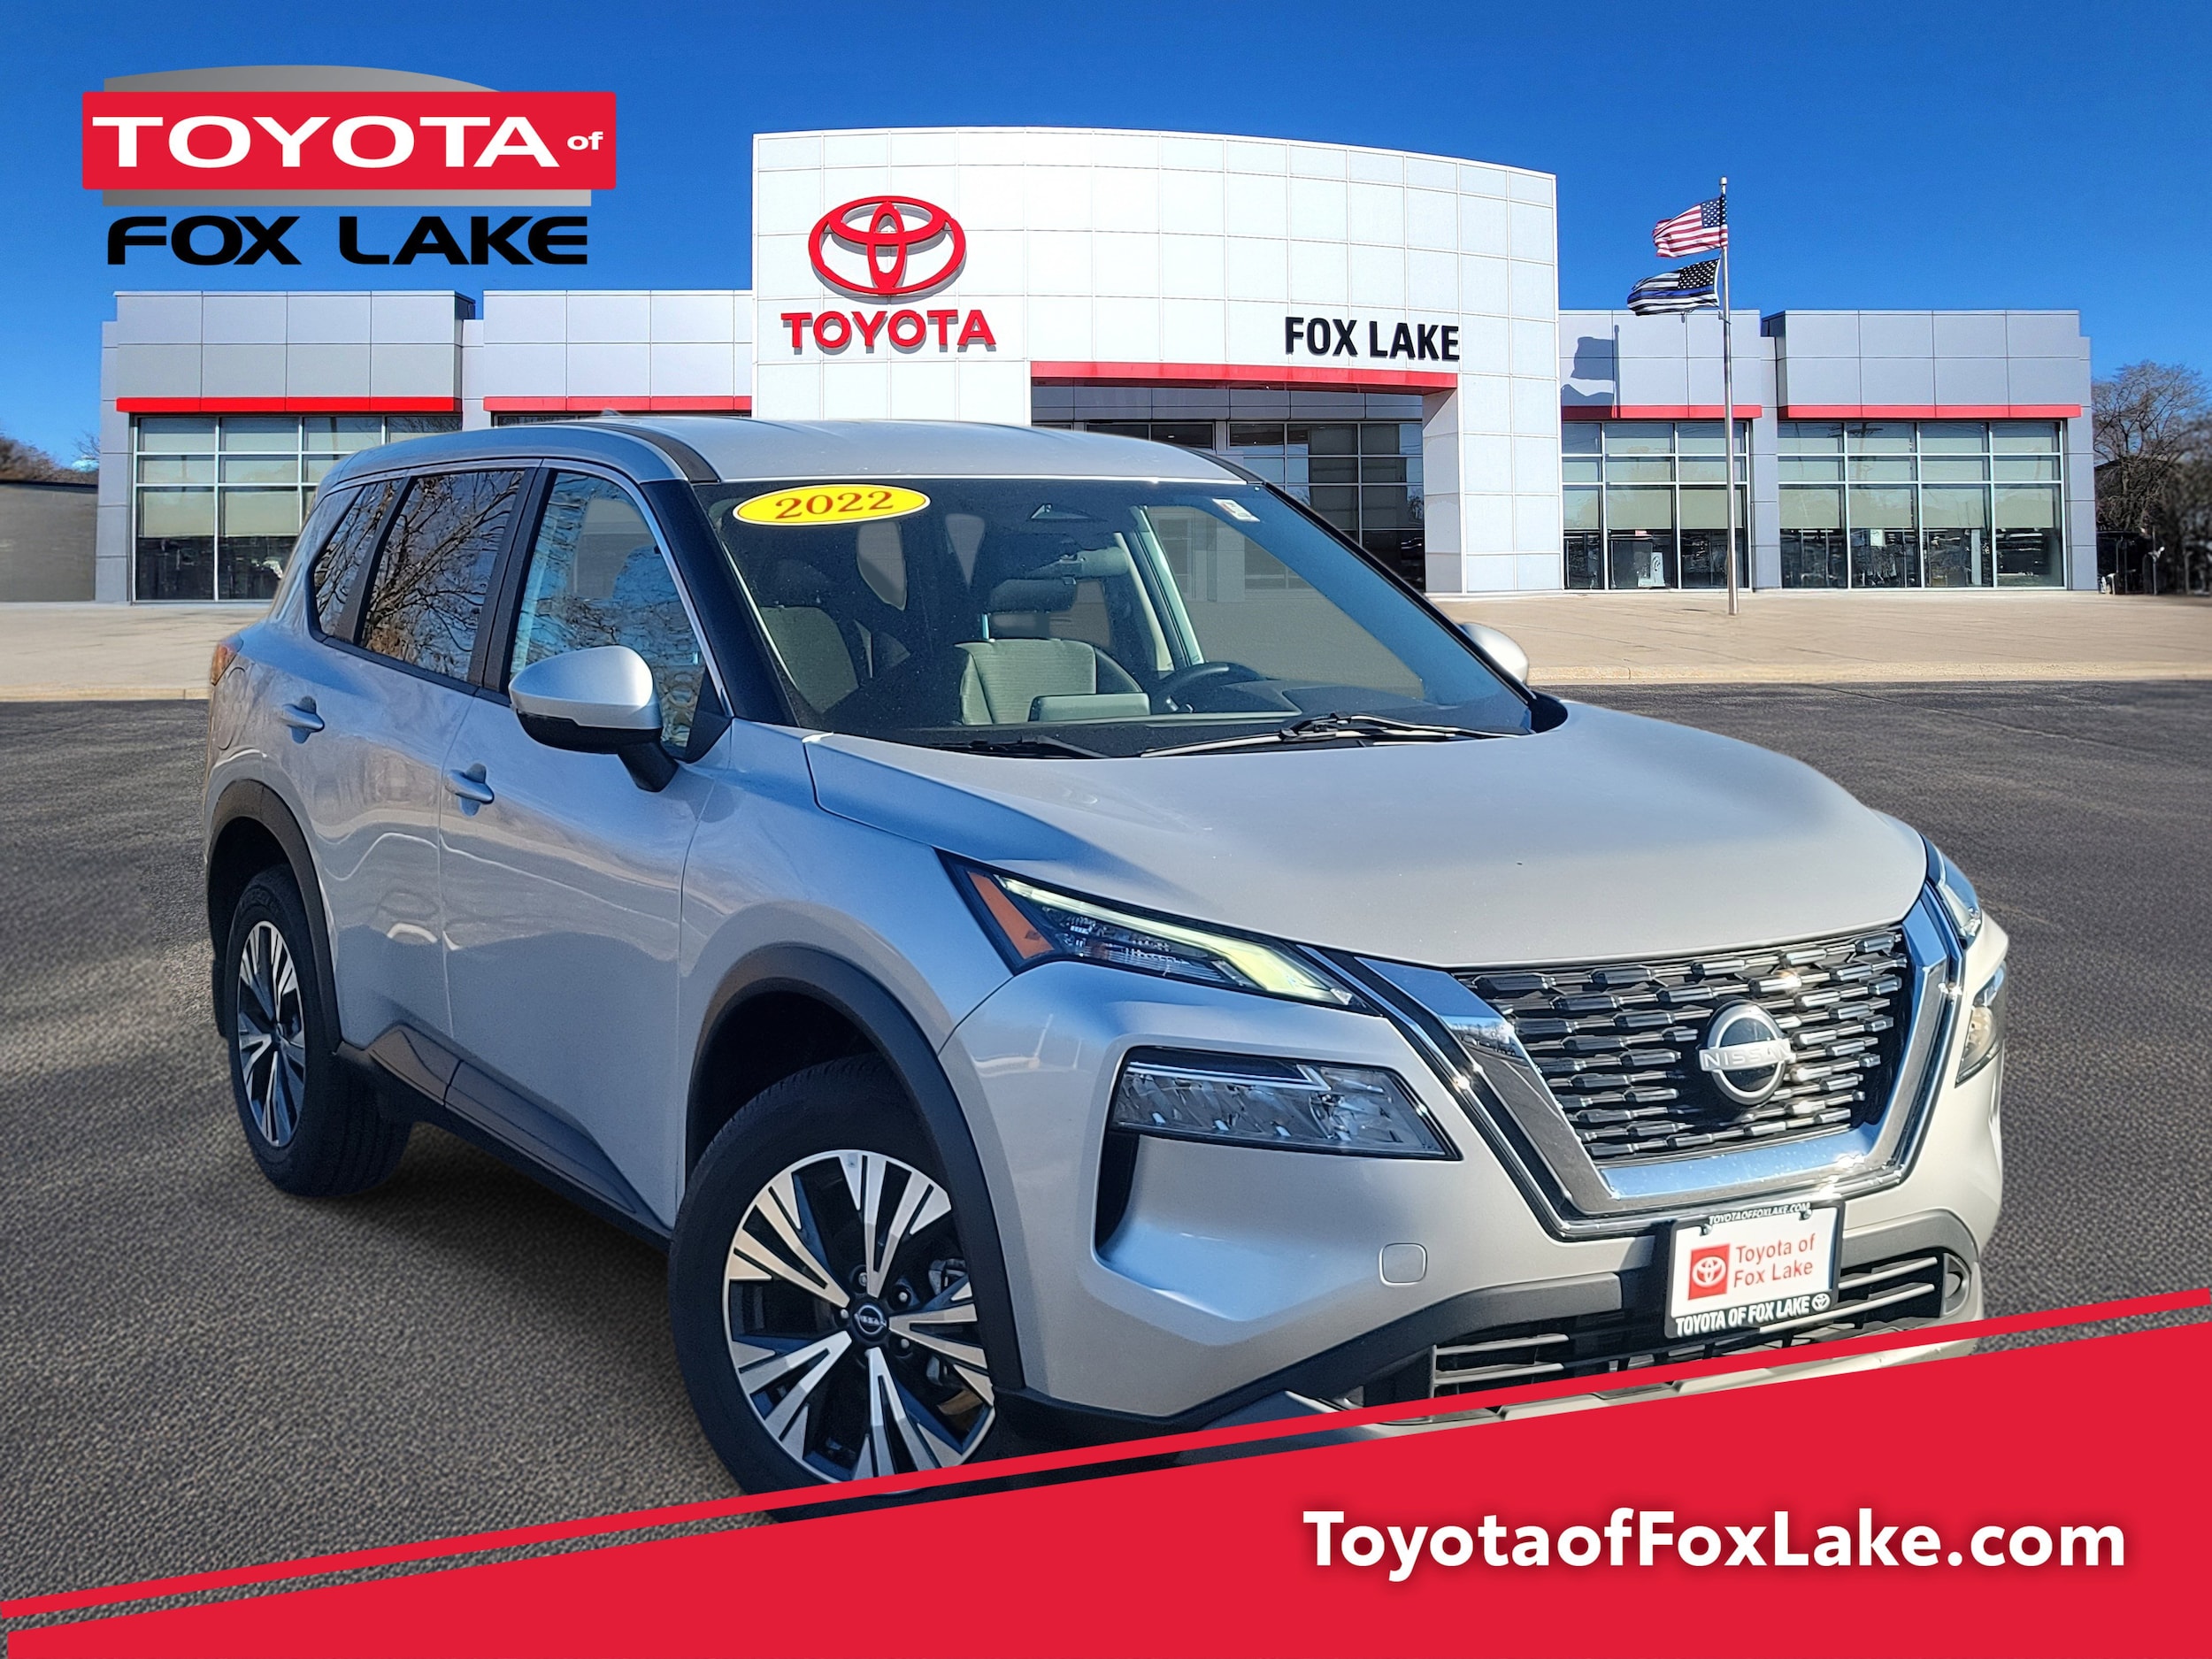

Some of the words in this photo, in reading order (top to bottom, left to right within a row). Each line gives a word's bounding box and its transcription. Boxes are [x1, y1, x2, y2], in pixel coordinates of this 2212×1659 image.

[781, 308, 997, 355] TOYOTA
[1285, 316, 1358, 358] FOX
[1369, 322, 1461, 362] LAKE
[775, 491, 893, 518] 2022
[1703, 1043, 1790, 1068] NISSAN
[1709, 1202, 1810, 1225] TOYOTAOFFOXLAKE.COM
[1736, 1240, 1792, 1264] Toyota
[1798, 1233, 1816, 1253] of
[1734, 1270, 1766, 1287] Fox
[1772, 1260, 1813, 1281] Lake
[1676, 1310, 1725, 1337] TOYOTA
[1728, 1306, 1747, 1327] OF
[1747, 1301, 1775, 1324] FOX
[1776, 1295, 1810, 1318] LAKE
